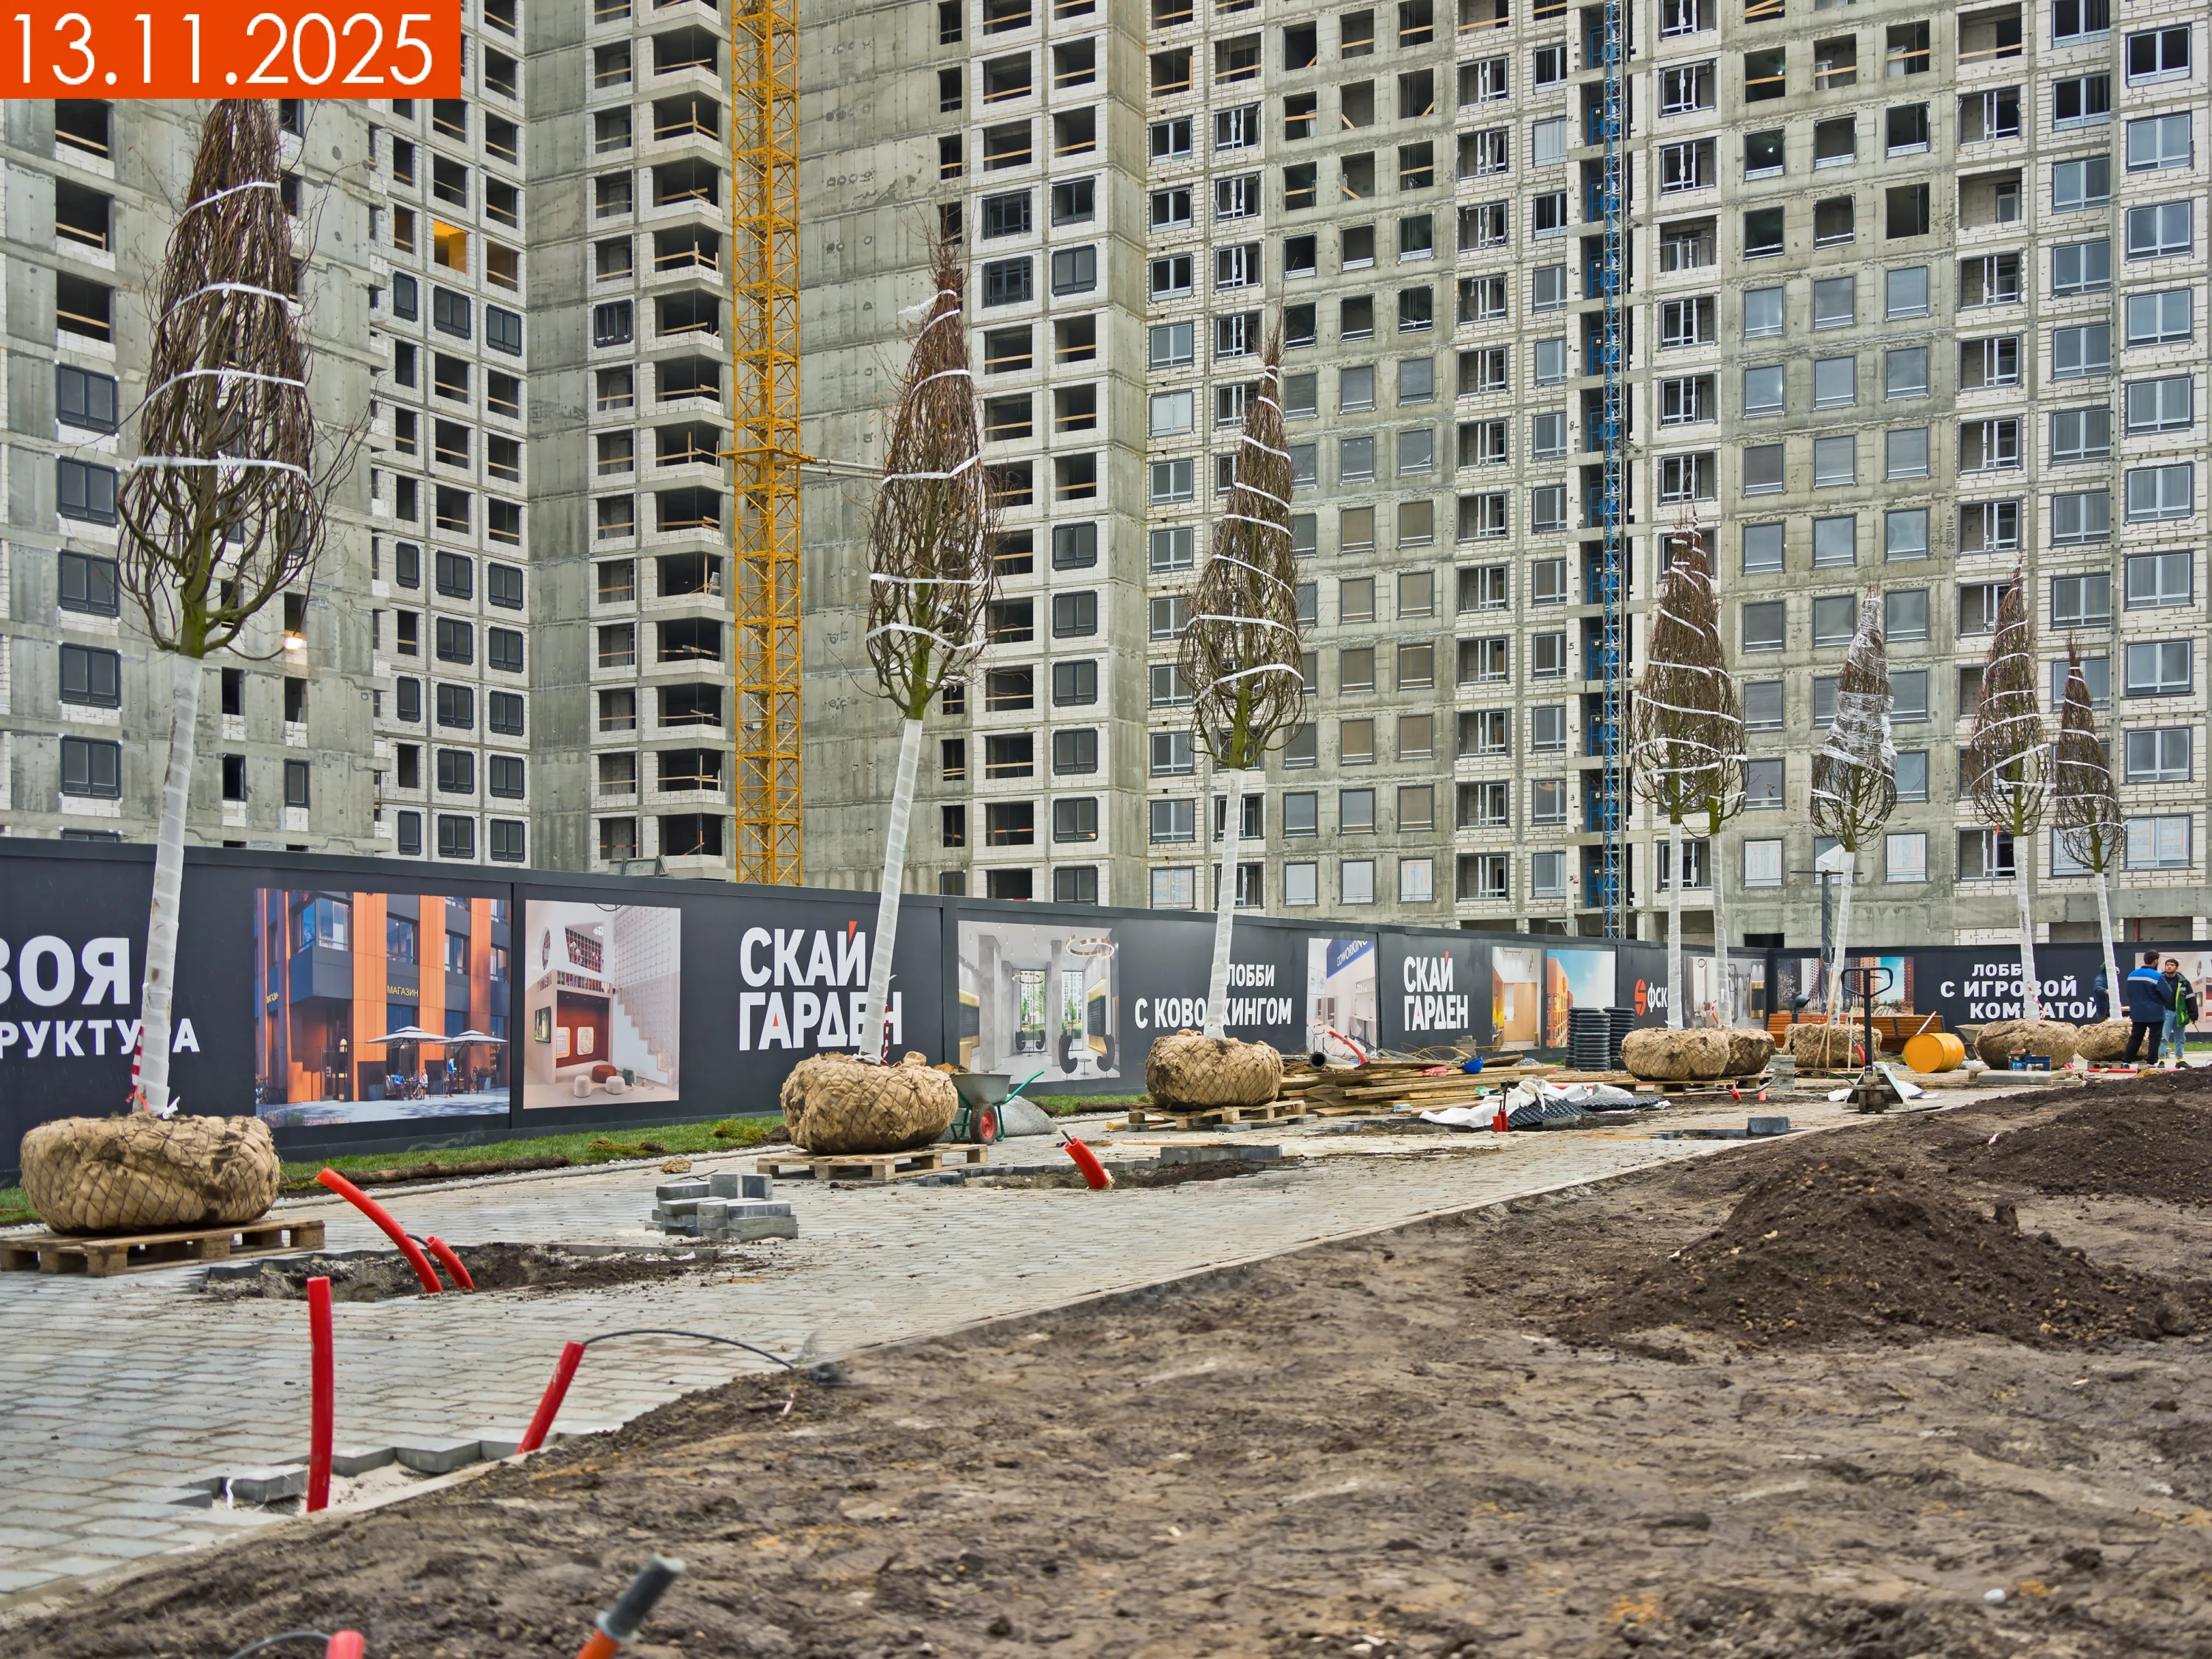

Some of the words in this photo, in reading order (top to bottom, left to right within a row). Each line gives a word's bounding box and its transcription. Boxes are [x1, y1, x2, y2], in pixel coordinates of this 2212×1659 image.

[1569, 420, 1575, 431] 8
[1568, 642, 1575, 650] 5
[740, 921, 866, 987] СКАЙ
[0, 935, 131, 1007] ОЯ
[1403, 951, 1454, 993] СКАЙ
[1972, 964, 2023, 977] ЛОББ
[387, 985, 419, 997] МАГАЗИН
[1940, 981, 1955, 998] С
[1134, 998, 1149, 1029] С
[1404, 995, 1469, 1031] ГАРДЕН
[1969, 997, 2097, 1019] КОМАТОЙ
[0, 1018, 201, 1059] РУКТУА
